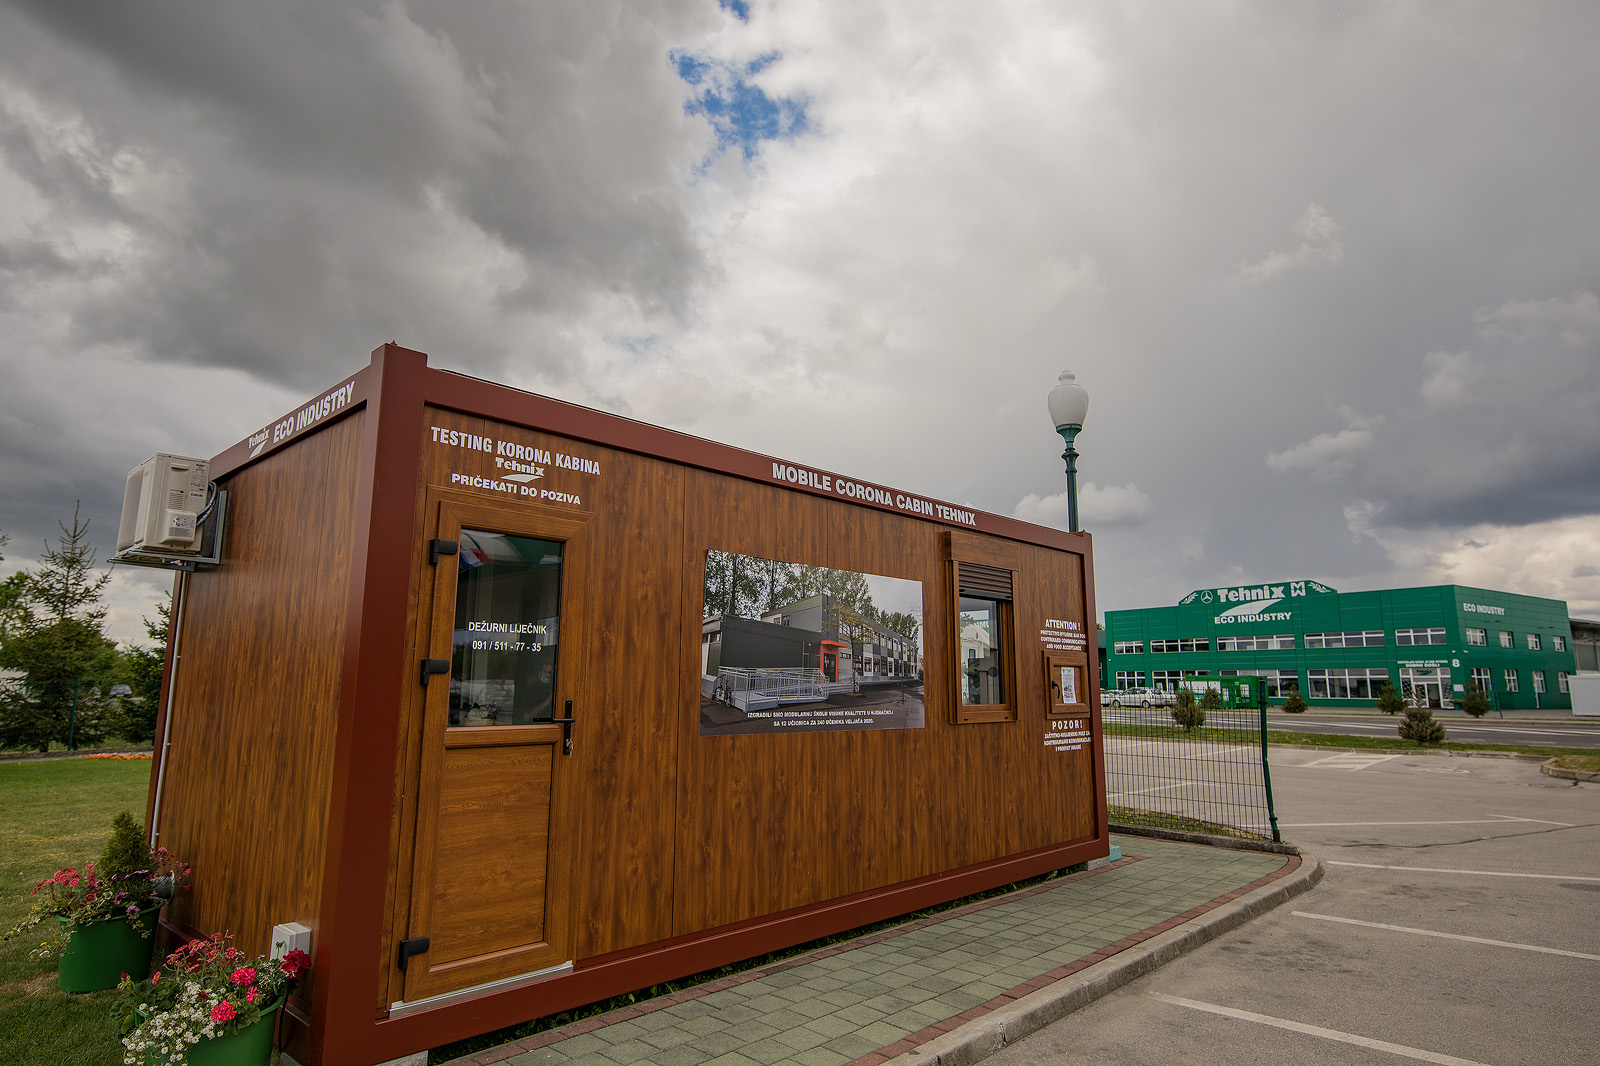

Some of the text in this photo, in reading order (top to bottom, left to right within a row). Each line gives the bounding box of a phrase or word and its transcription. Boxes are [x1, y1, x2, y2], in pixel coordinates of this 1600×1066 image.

[273, 380, 355, 443] ECO INDUSTRY
[248, 427, 270, 449] Tehnix
[430, 426, 601, 476] TESTING KORONA KABINA
[495, 457, 545, 477] Tehnix
[451, 473, 581, 505] PRIČEKATI DO POZIVA
[772, 462, 976, 526] MOBILE CORONA CABIN TEHNIX
[1217, 585, 1286, 603] Tehnix
[1463, 602, 1505, 616] ECO INDUSTRY
[1045, 619, 1077, 630] ATTENTION
[1214, 611, 1292, 625] ECO INDUSTRY
[468, 620, 547, 635] DEŽURNI LIJEČNIK
[472, 640, 487, 650] 091
[494, 641, 508, 651] 511
[515, 642, 525, 651] 77
[531, 642, 542, 652] 35
[1451, 658, 1460, 668] 8
[1052, 720, 1083, 730] POZOR!
